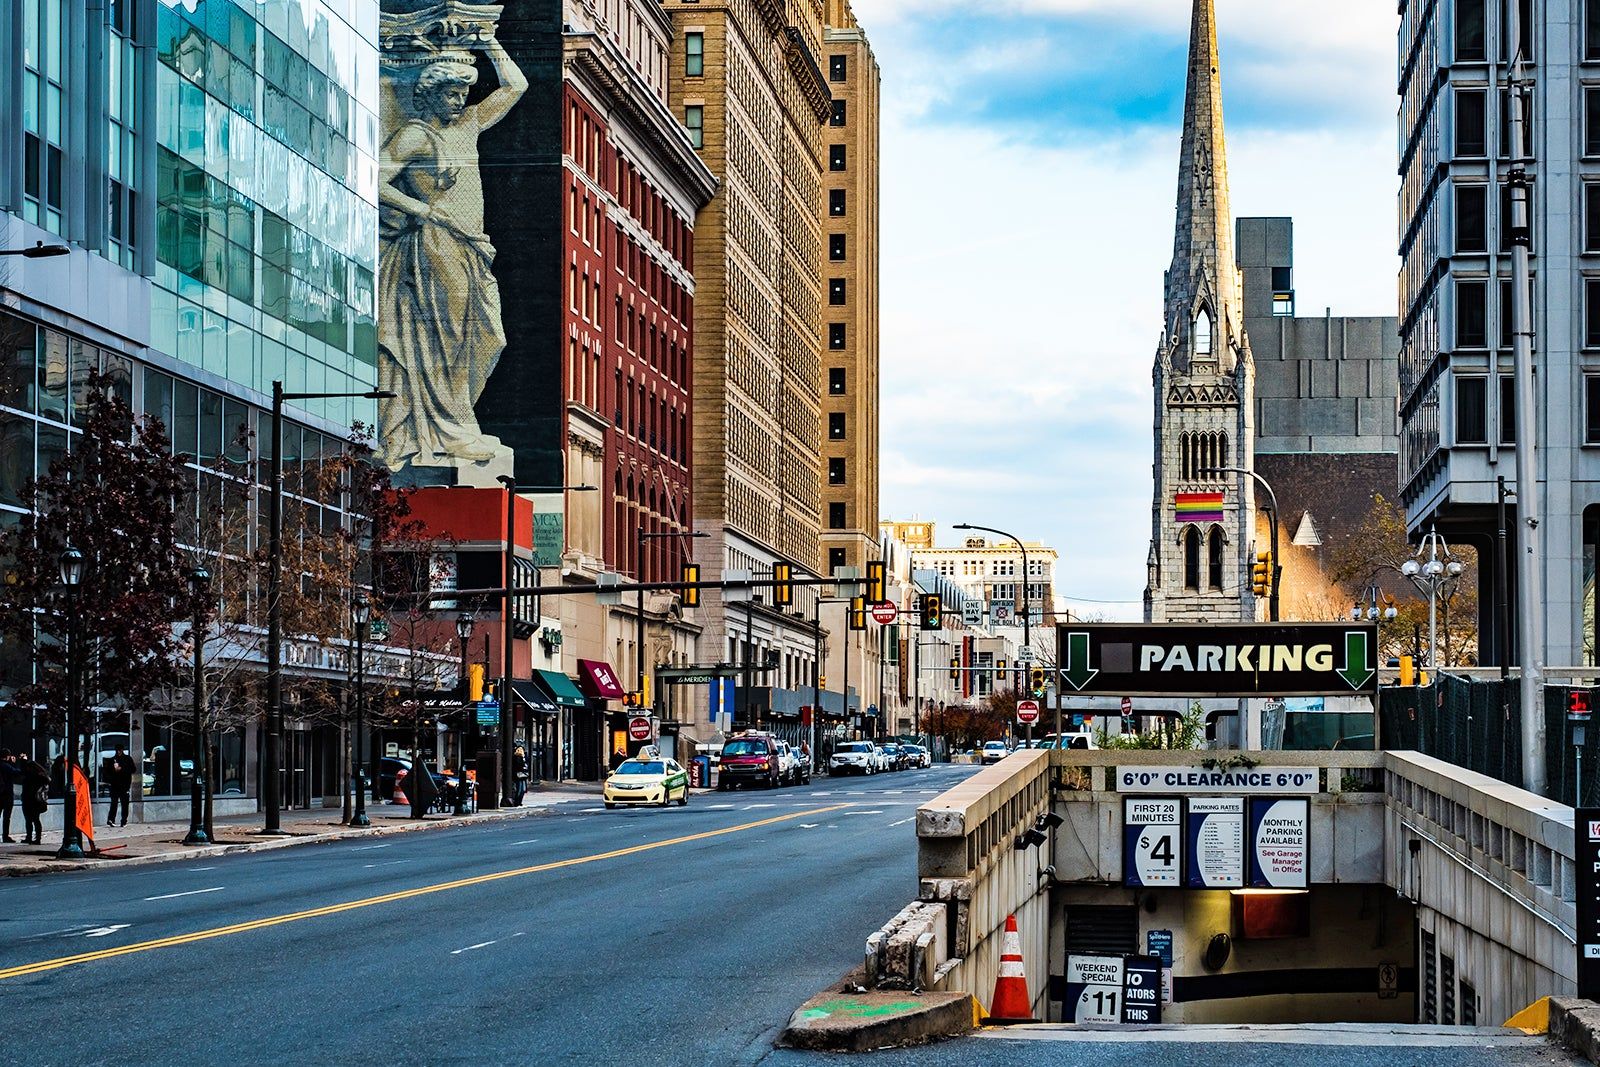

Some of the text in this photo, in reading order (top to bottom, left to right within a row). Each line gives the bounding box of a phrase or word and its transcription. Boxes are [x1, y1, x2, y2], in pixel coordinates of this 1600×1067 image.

[1140, 644, 1334, 672] PARKING
[692, 778, 699, 787] AL
[1164, 773, 1272, 786] CLEARANCE
[1134, 804, 1175, 812] FIRST 20
[1277, 850, 1302, 858] Garage
[1076, 963, 1118, 973] WEEKEND
[1082, 973, 1117, 982] SPECIAL
[1126, 988, 1155, 1000] ATORS
[1126, 1009, 1148, 1020] THIS
